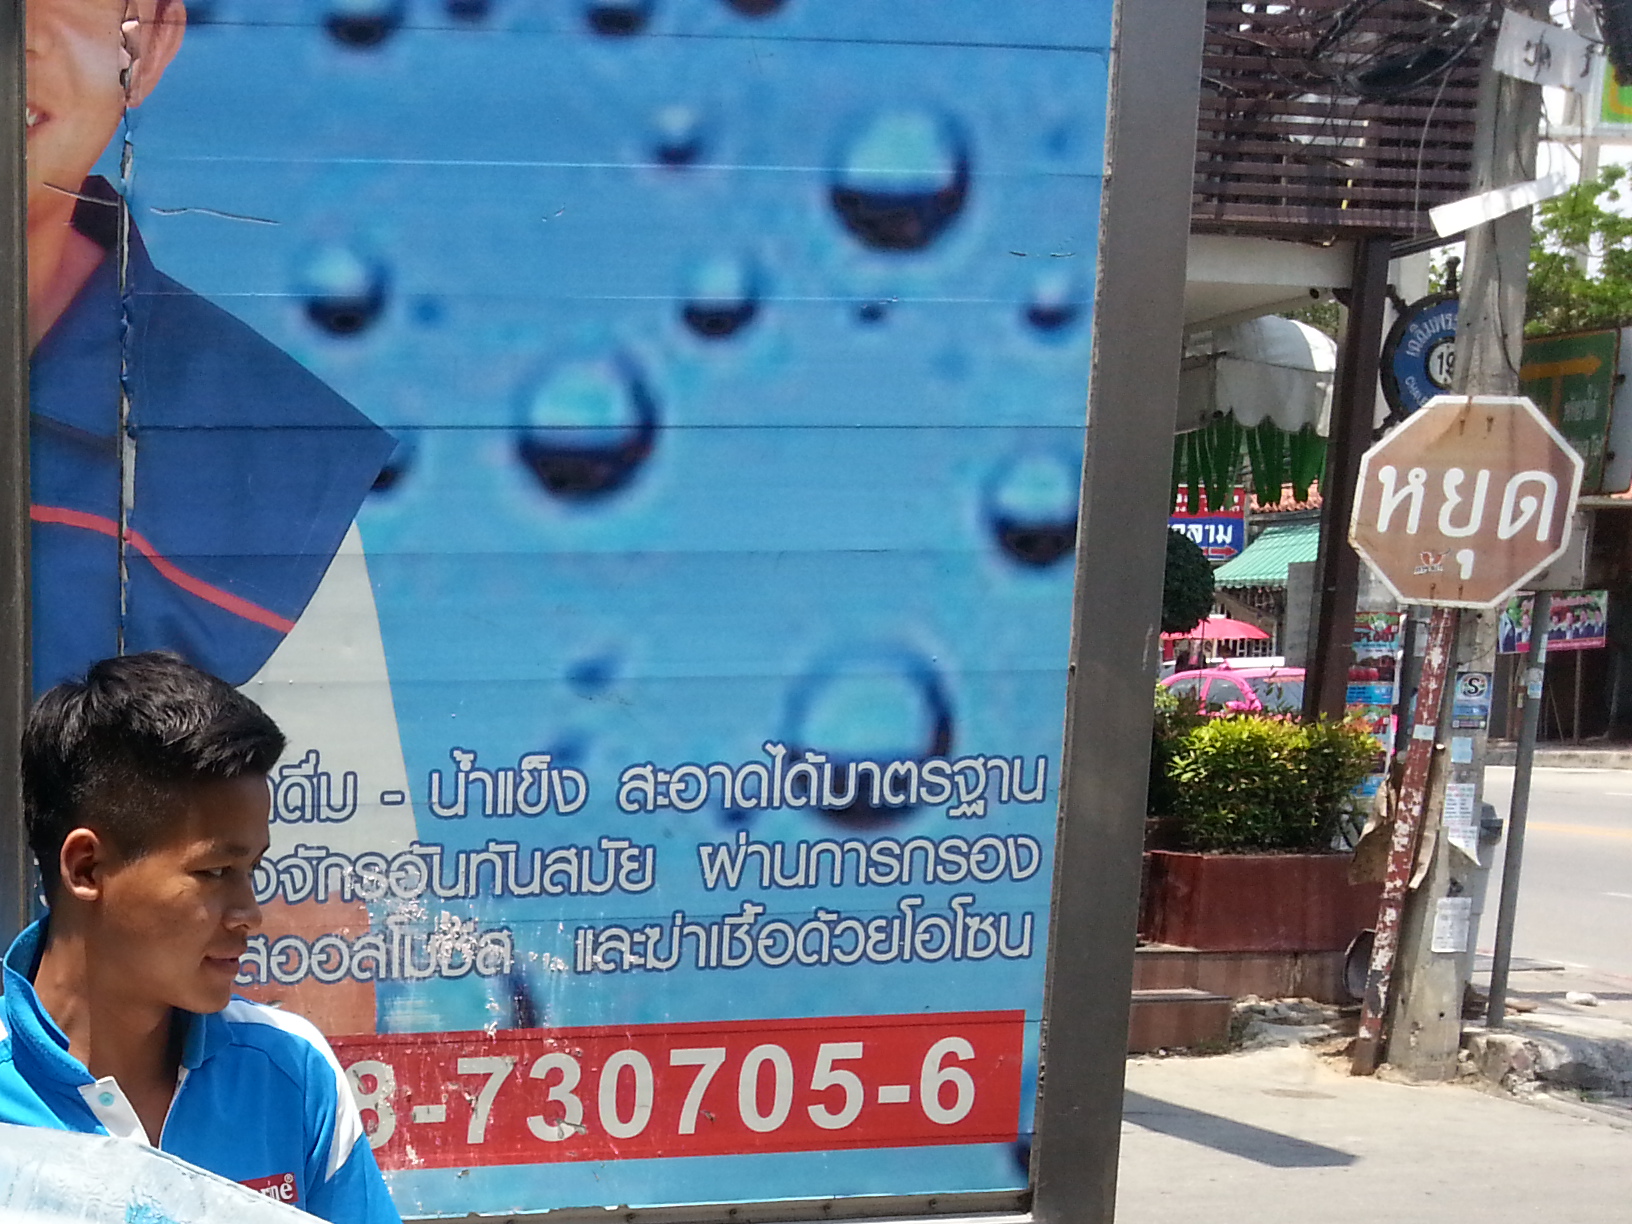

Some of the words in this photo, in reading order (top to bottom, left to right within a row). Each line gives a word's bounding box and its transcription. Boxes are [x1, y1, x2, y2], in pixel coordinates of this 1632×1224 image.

[1377, 465, 1558, 580] หยุด
[429, 747, 589, 821] น้ำแข็ง
[617, 741, 1048, 818] สะอาดได้มาตรฐาน
[698, 829, 1041, 892] ผ่านการกรอง
[574, 895, 1034, 974] และฆ่าเชื้อด้วยโอโซน
